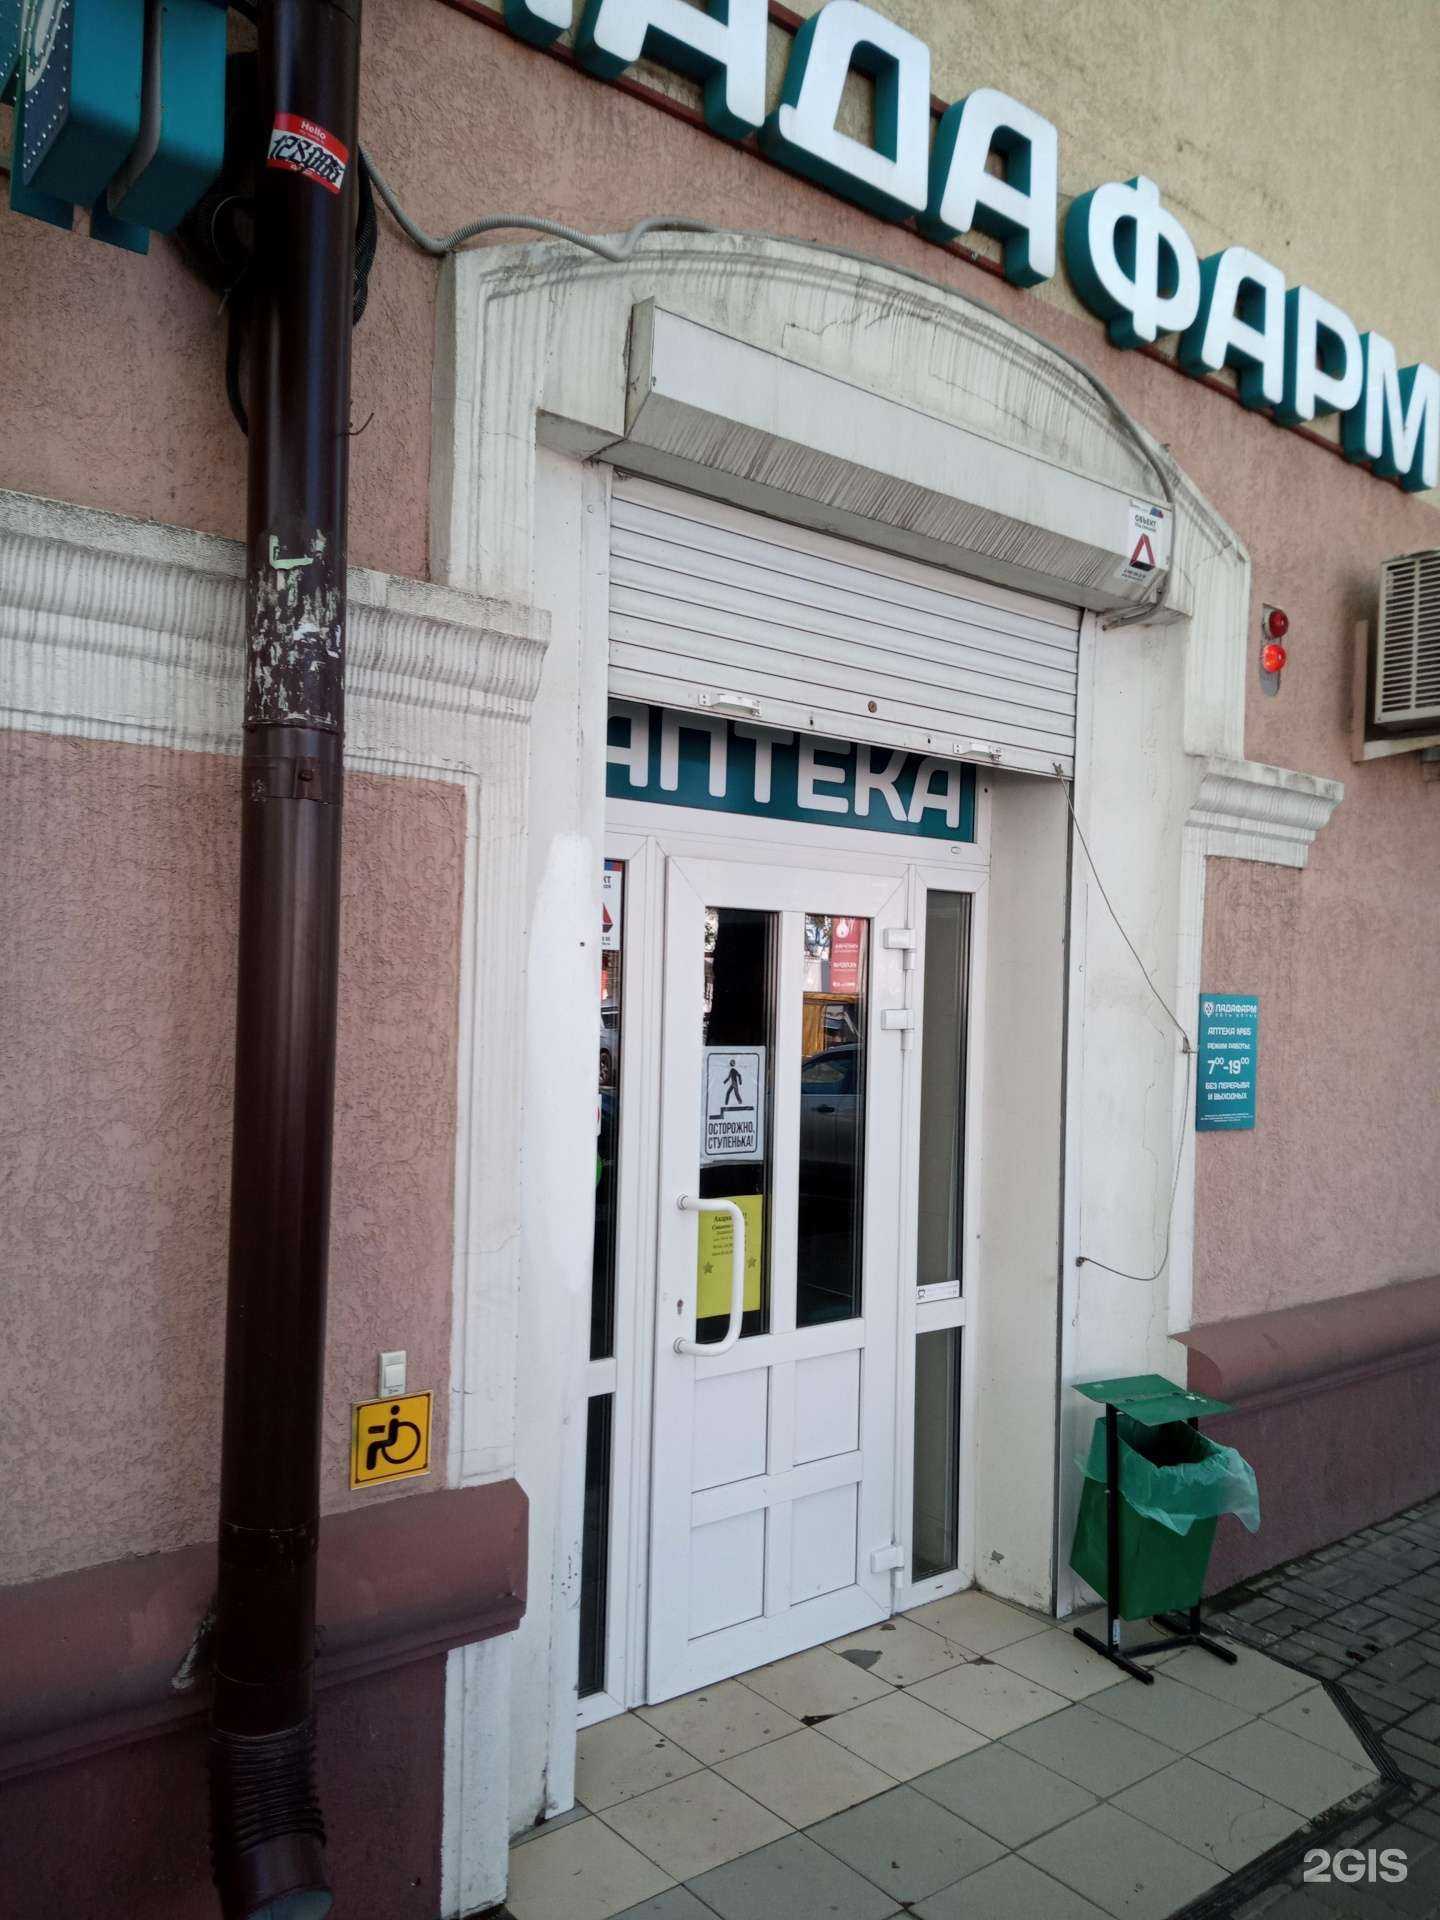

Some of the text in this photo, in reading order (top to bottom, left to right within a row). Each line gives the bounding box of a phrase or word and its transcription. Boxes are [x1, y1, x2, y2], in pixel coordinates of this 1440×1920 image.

[301, 121, 326, 139] Hello
[525, 0, 1440, 488] АДАФАРМ
[606, 697, 963, 829] АПТЕКА
[1207, 1026, 1235, 1036] АПТЕКА
[1205, 1082, 1217, 1090] БЕЗ
[708, 1121, 755, 1135] ОСТОРОЖНО,
[708, 1135, 753, 1149] СТУПЕНЬКА!
